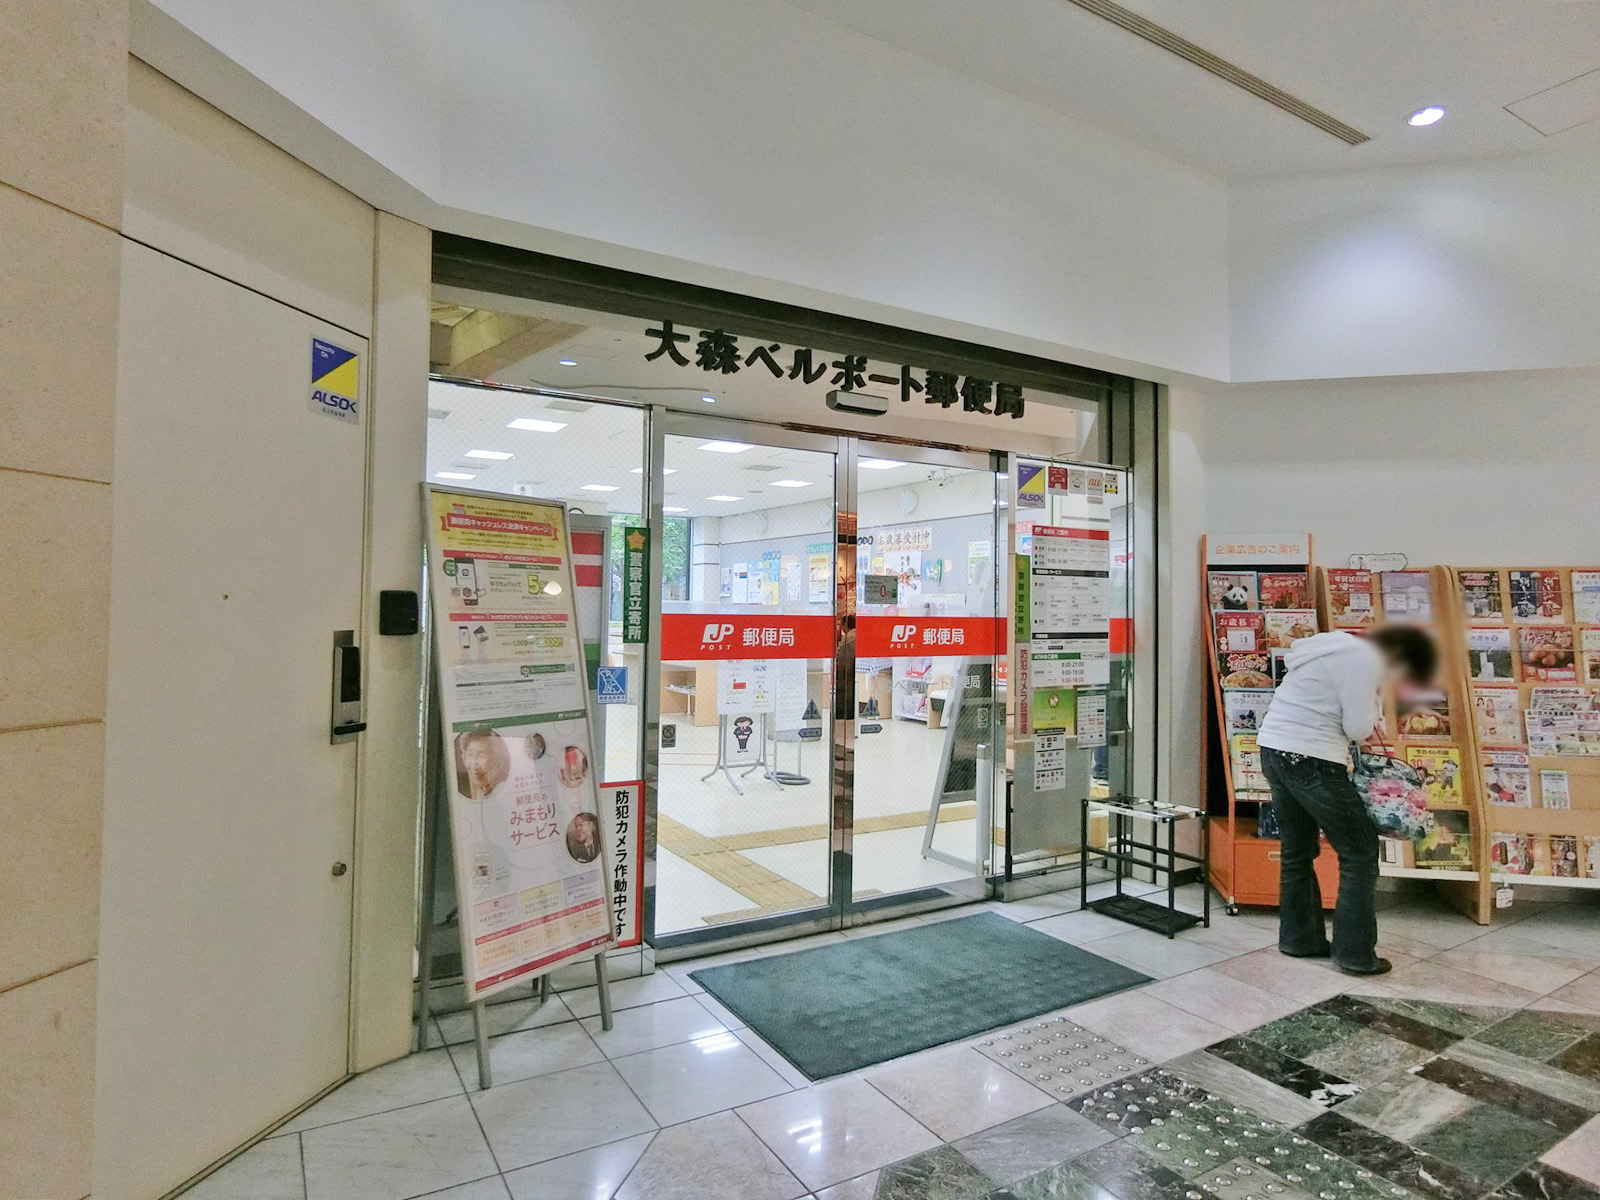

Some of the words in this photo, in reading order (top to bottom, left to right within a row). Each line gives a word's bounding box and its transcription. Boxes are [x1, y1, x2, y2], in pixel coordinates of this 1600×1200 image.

[645, 320, 1025, 420] 大森ベルポート郵便局
[311, 390, 357, 413] ALSOK
[1018, 493, 1044, 503] ALSOK
[878, 530, 930, 545] お歳暮受付中
[1215, 544, 1300, 554] 企業広告のご案内
[628, 551, 643, 640] 警察官立寄所
[742, 627, 795, 647] 郵便局
[923, 628, 965, 645] 郵便局
[510, 803, 556, 826] みまもり
[510, 823, 560, 846] サービス
[614, 790, 630, 937] 防犯カメラ作動中です
